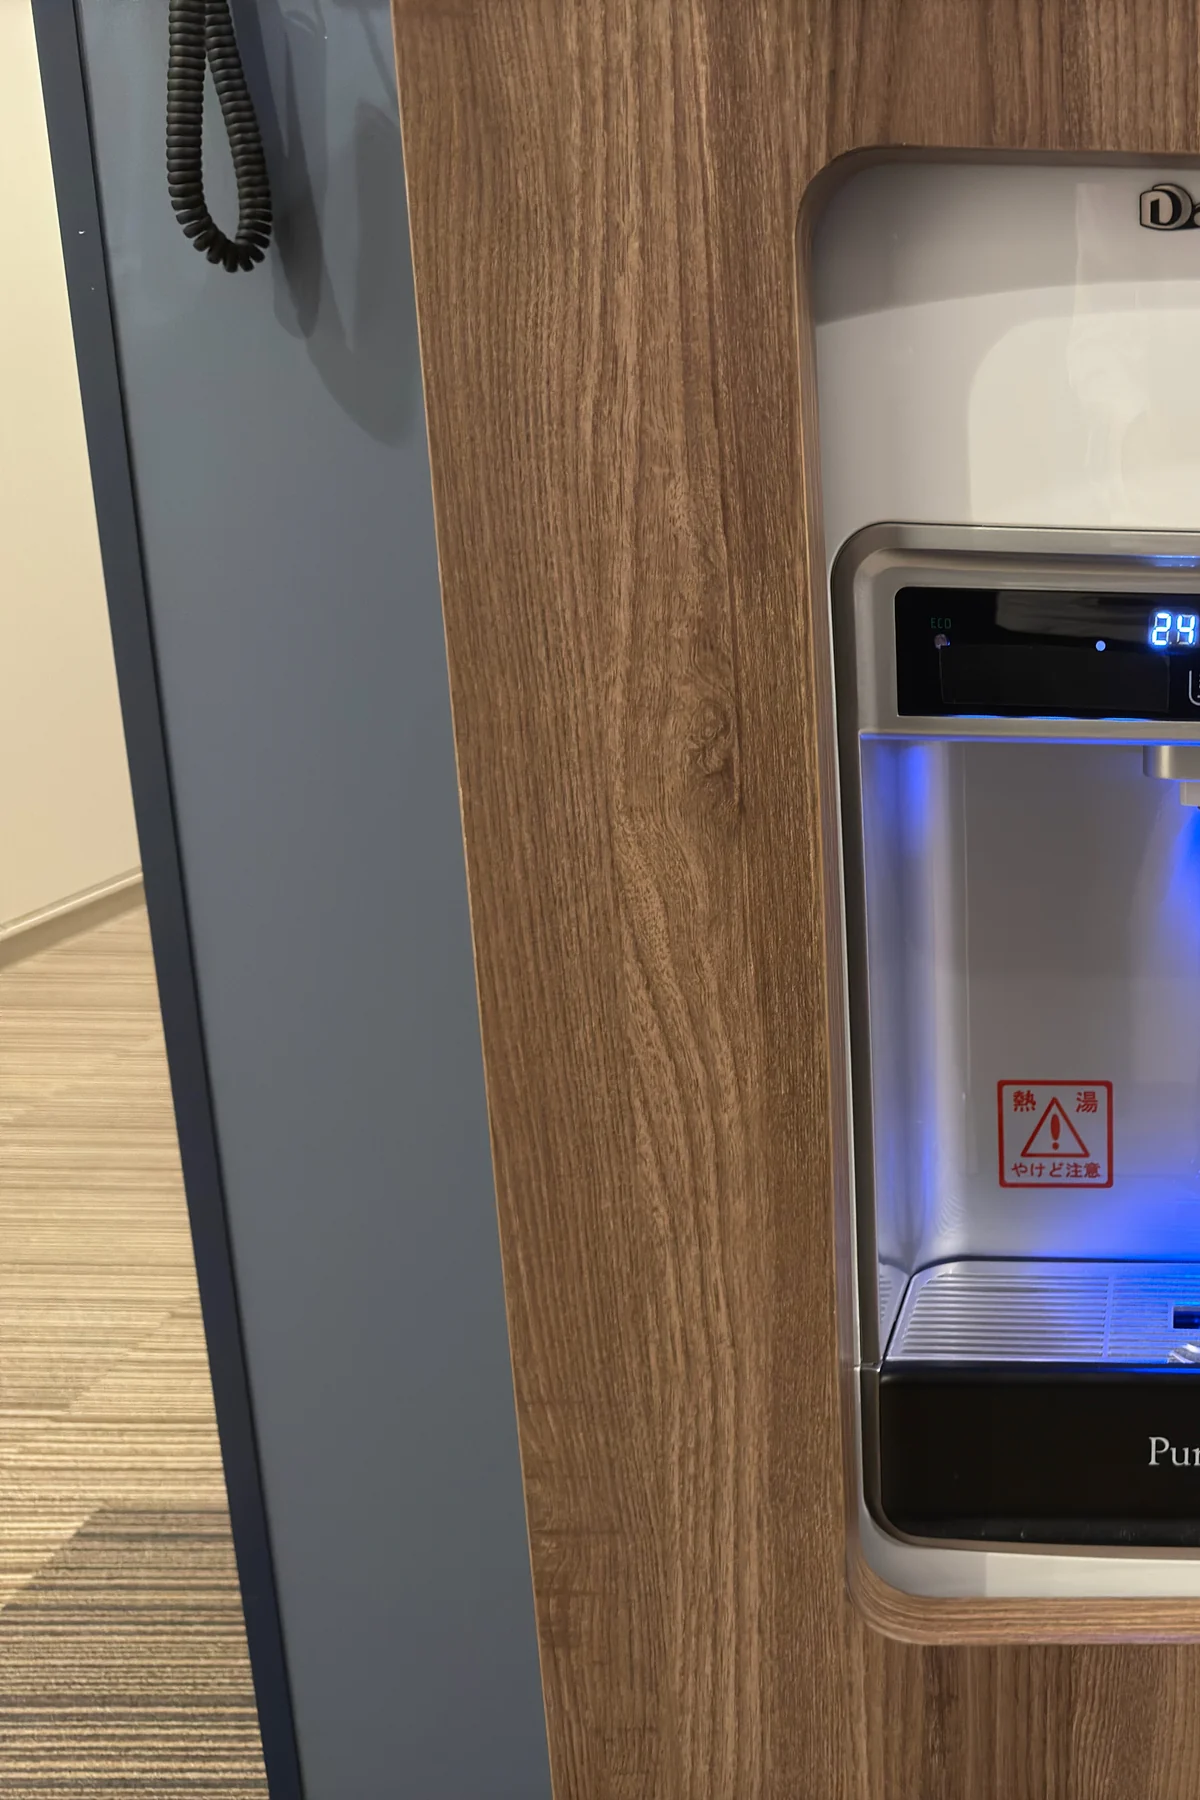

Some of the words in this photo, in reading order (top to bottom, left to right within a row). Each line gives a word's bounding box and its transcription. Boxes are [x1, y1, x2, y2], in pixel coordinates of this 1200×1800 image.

[930, 617, 952, 629] ECO
[1151, 612, 1196, 646] 24
[1012, 1089, 1037, 1113] 熱
[1075, 1090, 1099, 1114] 湯
[1011, 1161, 1102, 1179] やけど注意
